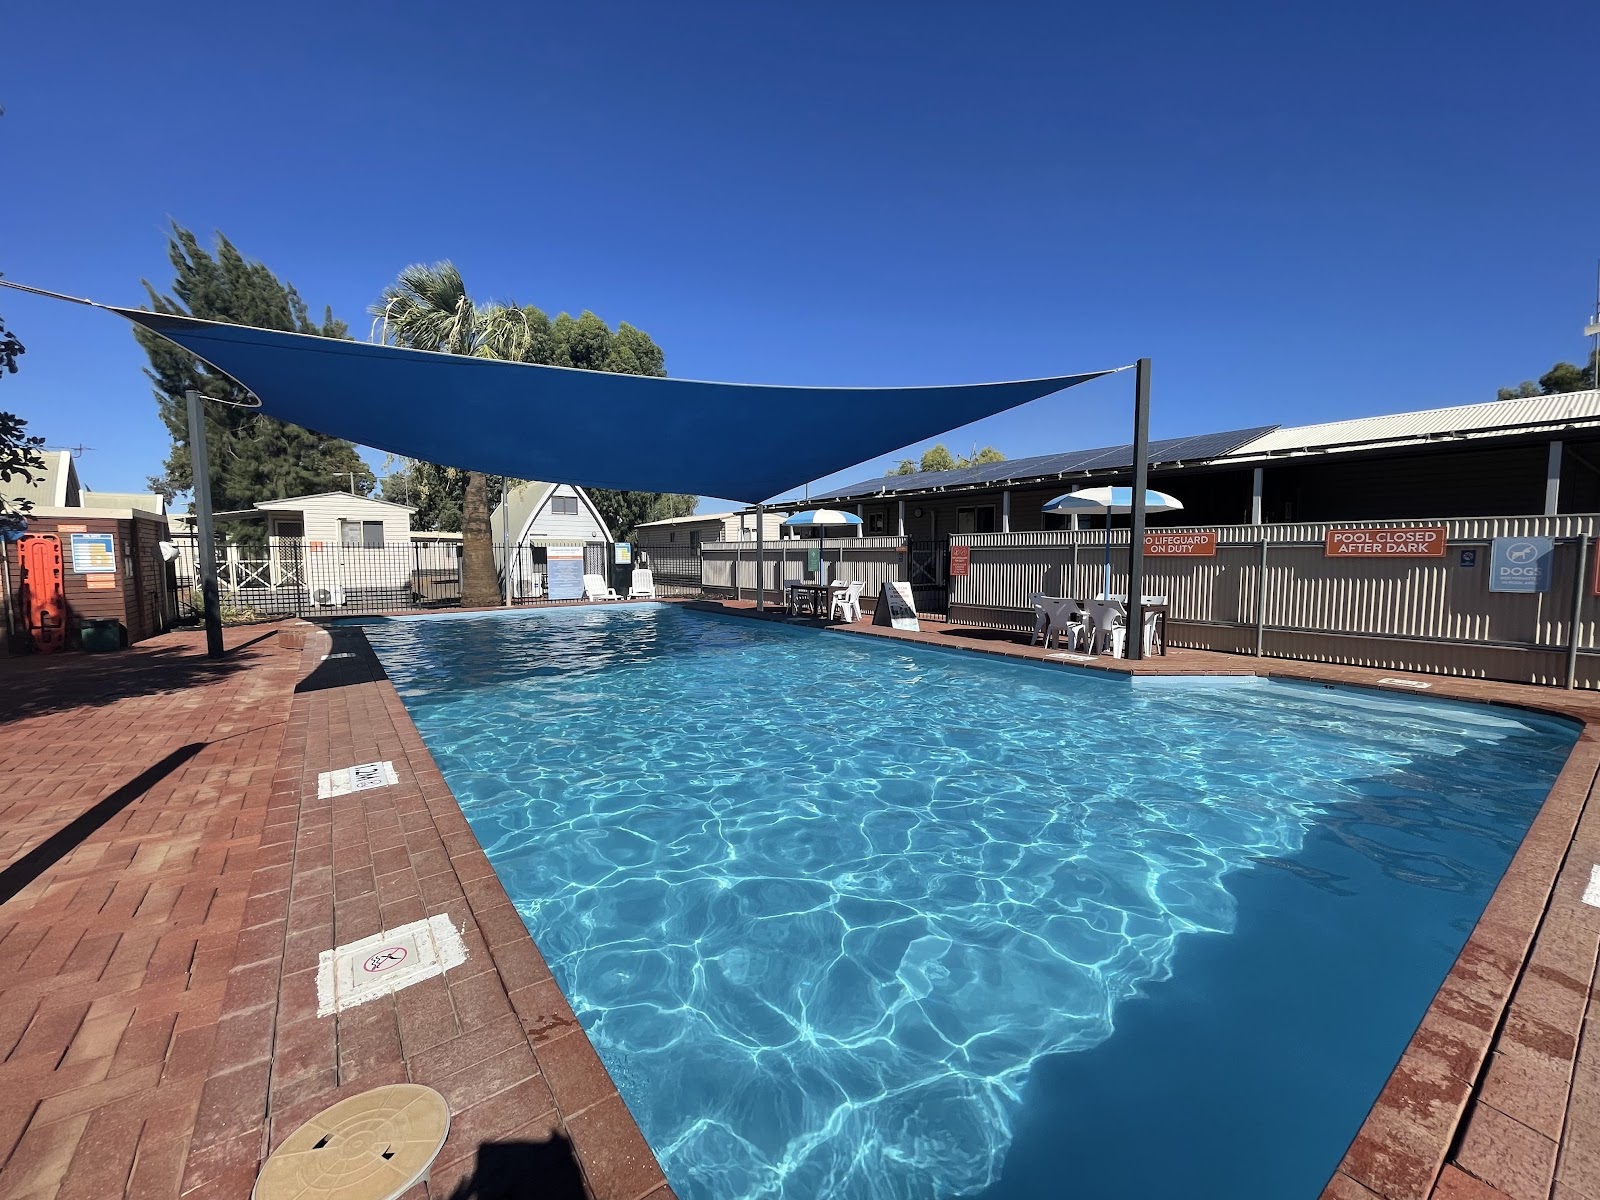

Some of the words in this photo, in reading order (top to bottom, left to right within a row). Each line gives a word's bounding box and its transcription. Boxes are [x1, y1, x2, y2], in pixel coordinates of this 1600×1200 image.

[1143, 537, 1153, 545] O
[1155, 536, 1209, 545] LIFEGUARD
[1334, 533, 1373, 543] POOL
[1376, 531, 1437, 543] CLOSED
[1150, 545, 1166, 553] ON
[1168, 545, 1194, 553] DUTY
[1338, 543, 1382, 553] AFTER
[1386, 542, 1429, 553] DARK
[1500, 567, 1542, 576] DOGS
